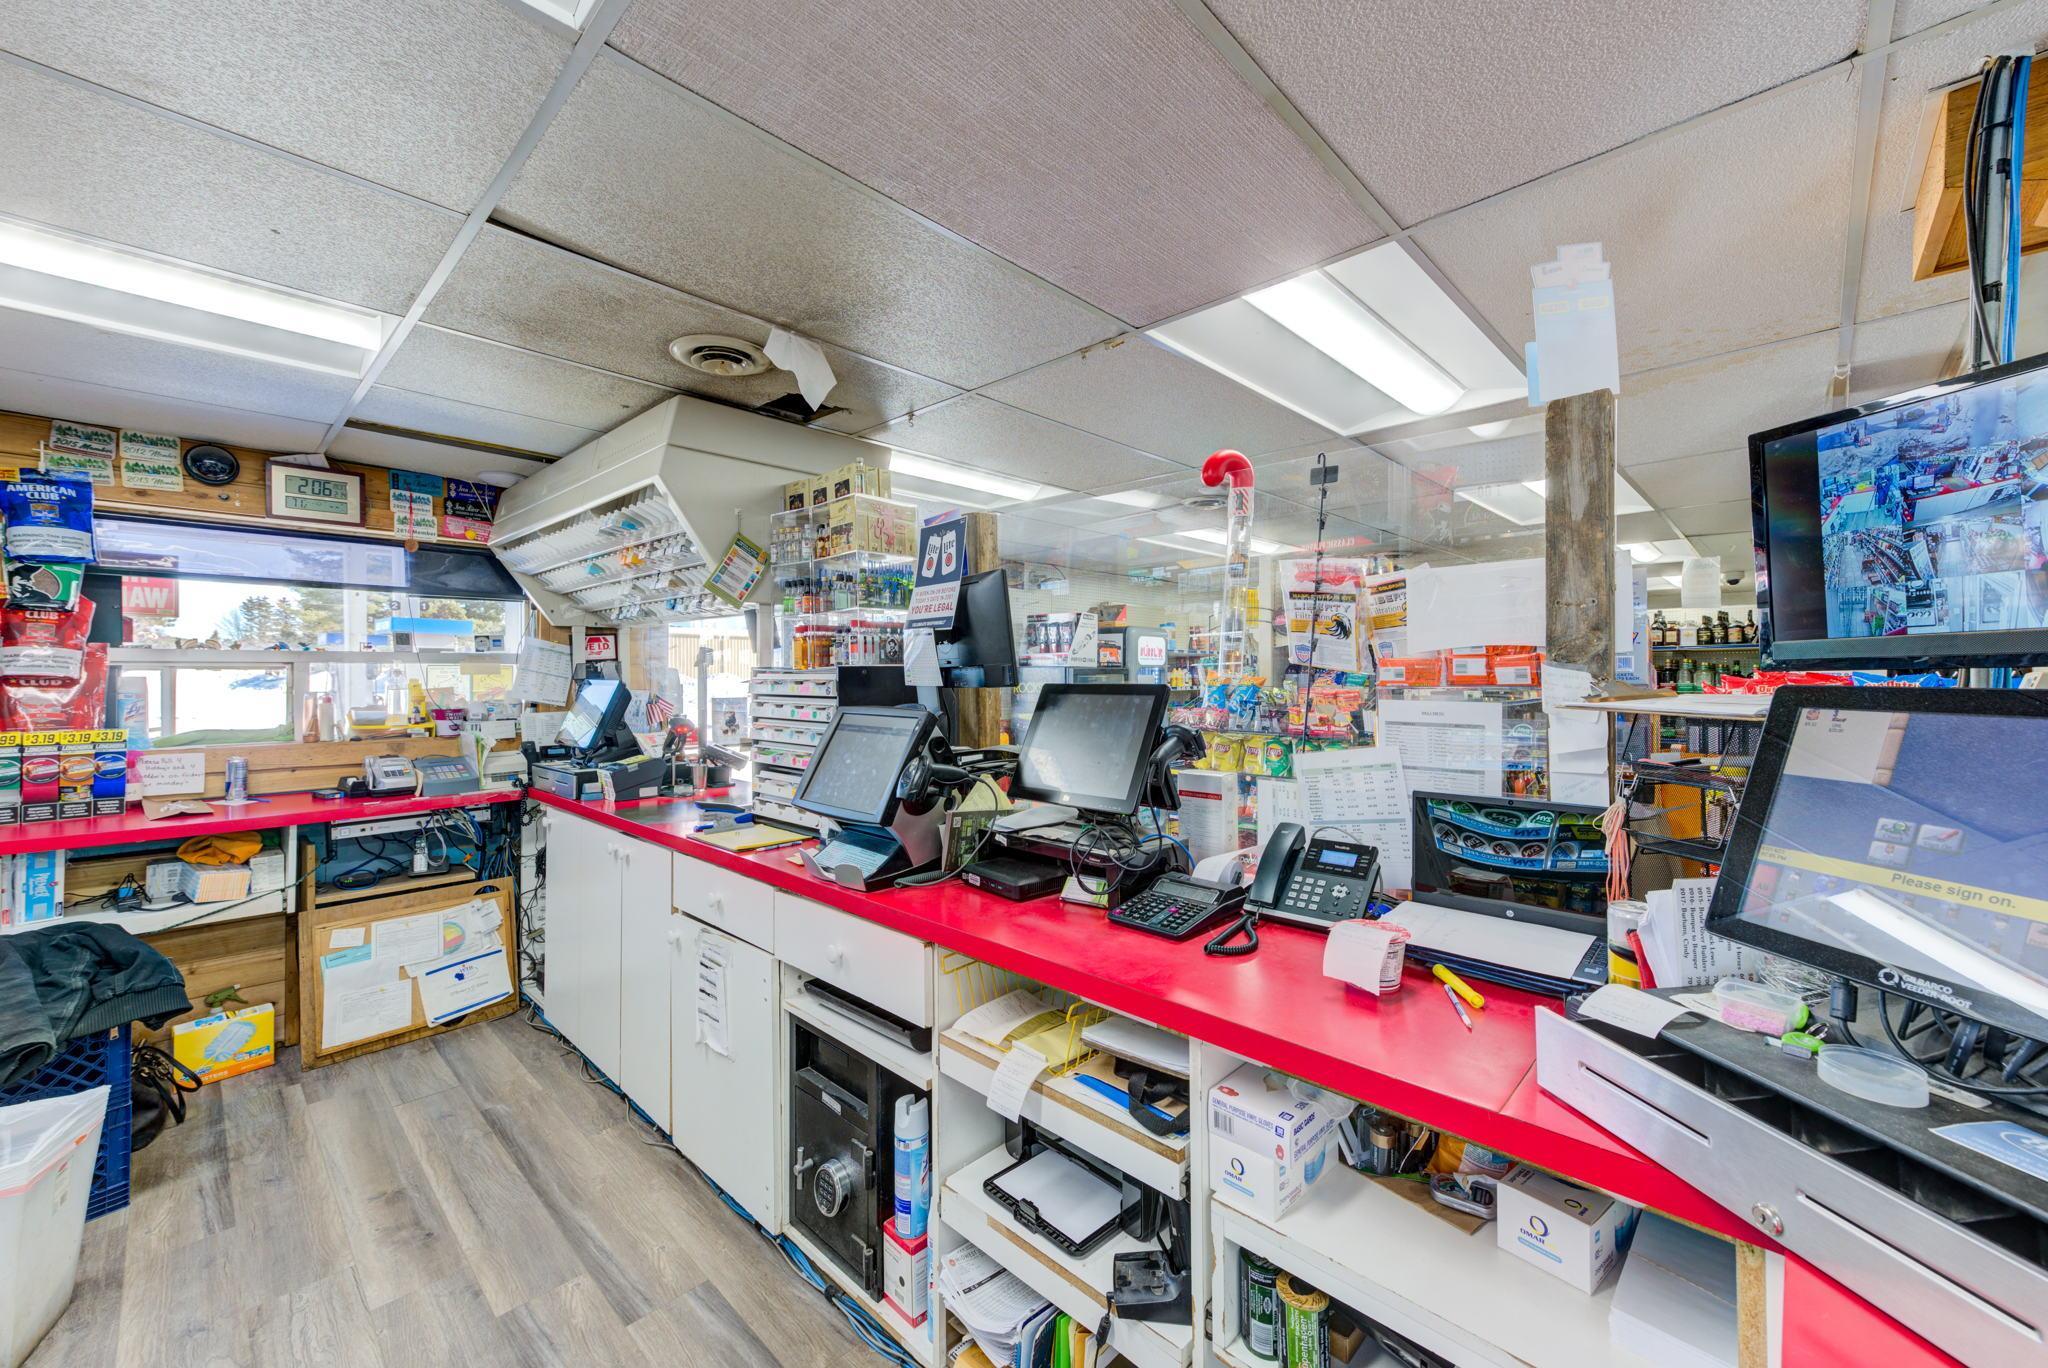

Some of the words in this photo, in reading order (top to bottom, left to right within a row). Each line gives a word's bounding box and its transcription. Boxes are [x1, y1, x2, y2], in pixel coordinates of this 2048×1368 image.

[6, 484, 77, 498] AMERICAN
[25, 491, 60, 500] CLUB
[928, 543, 940, 557] Lite
[943, 539, 956, 554] Lite
[25, 610, 59, 619] CLUB
[911, 604, 934, 615] YOU'RE
[933, 601, 954, 613] LEGAL
[1266, 747, 1282, 757] Lay's
[1891, 871, 1942, 893] Please
[1946, 885, 1983, 905] sign
[1988, 895, 2017, 909] on.
[1901, 972, 1954, 995] GILBARCO
[1900, 980, 1973, 1011] VEEDER-ROOT
[1212, 1096, 1228, 1110] GENERAL
[1228, 1104, 1246, 1118] PURPOSE
[1259, 1116, 1274, 1130] GLOVES
[1293, 1122, 1305, 1137] BASIC
[1520, 1227, 1546, 1245] OMAR
